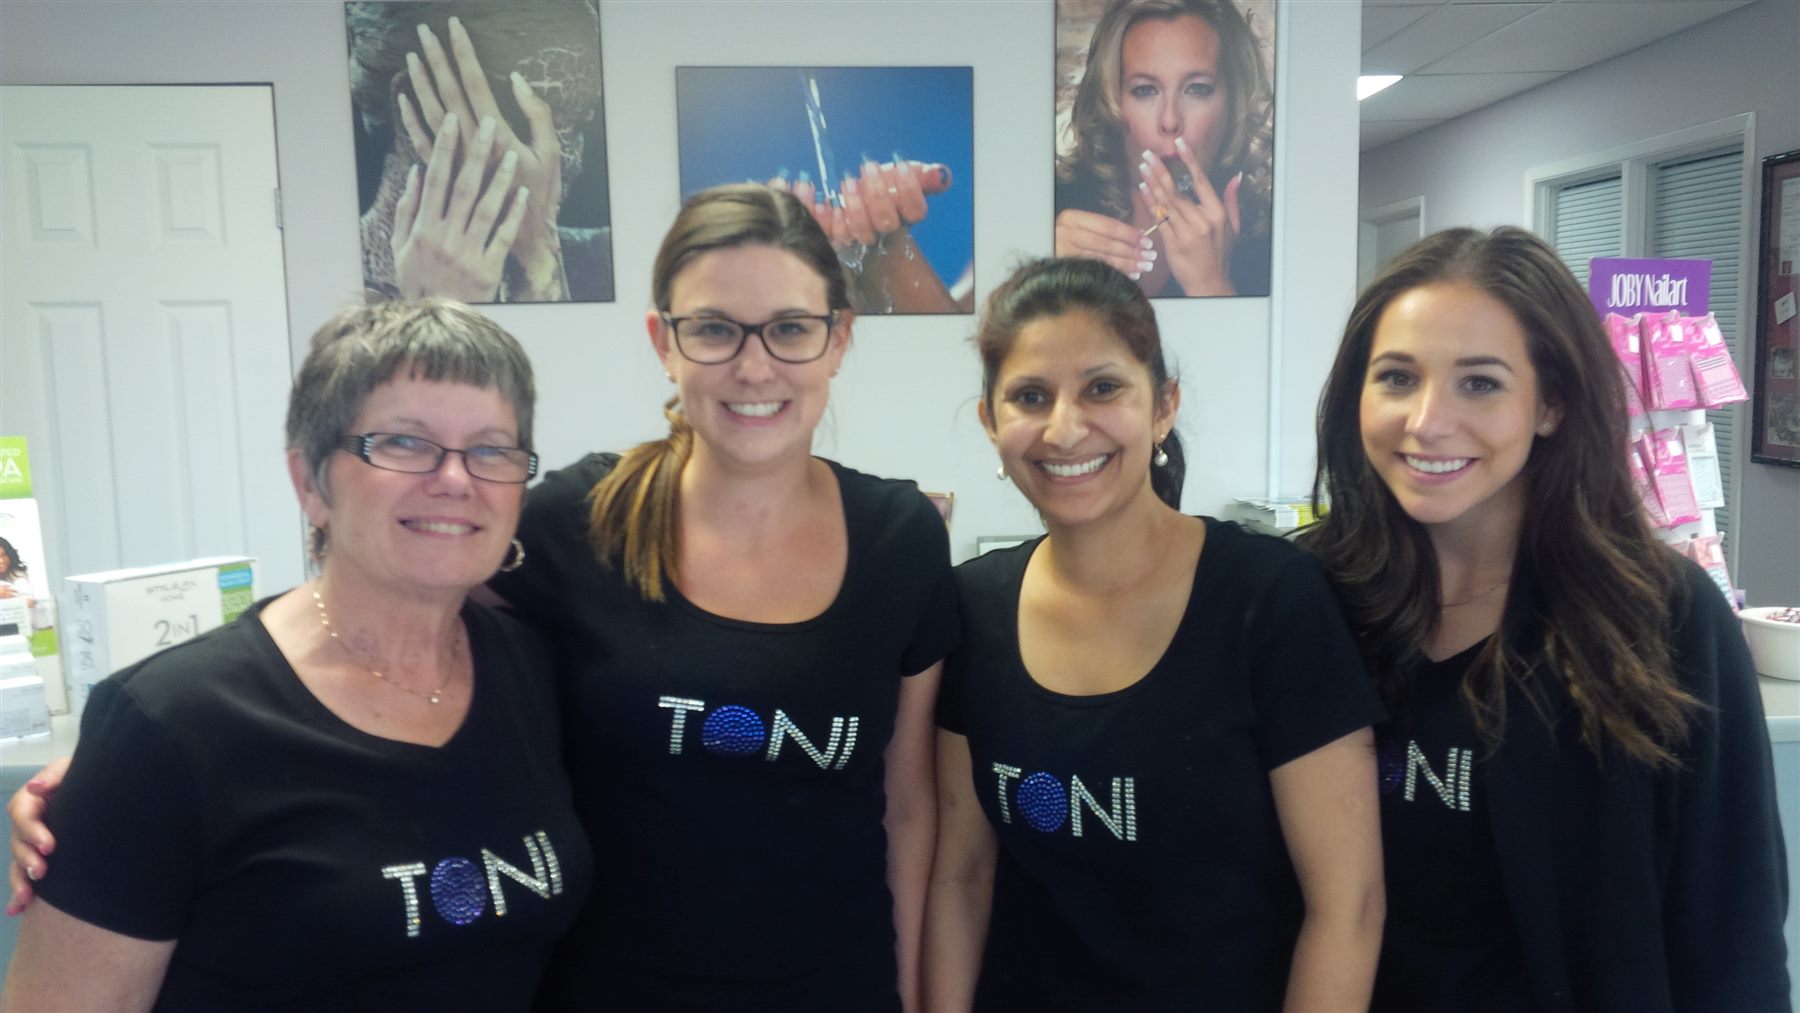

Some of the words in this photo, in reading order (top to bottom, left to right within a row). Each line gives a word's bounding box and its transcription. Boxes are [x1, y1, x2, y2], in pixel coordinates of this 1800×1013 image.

[1607, 273, 1645, 309] JOBY
[1643, 273, 1688, 307] Nailart
[658, 696, 859, 769] TONI
[992, 761, 1136, 841] TONI
[381, 830, 563, 937] TONI
